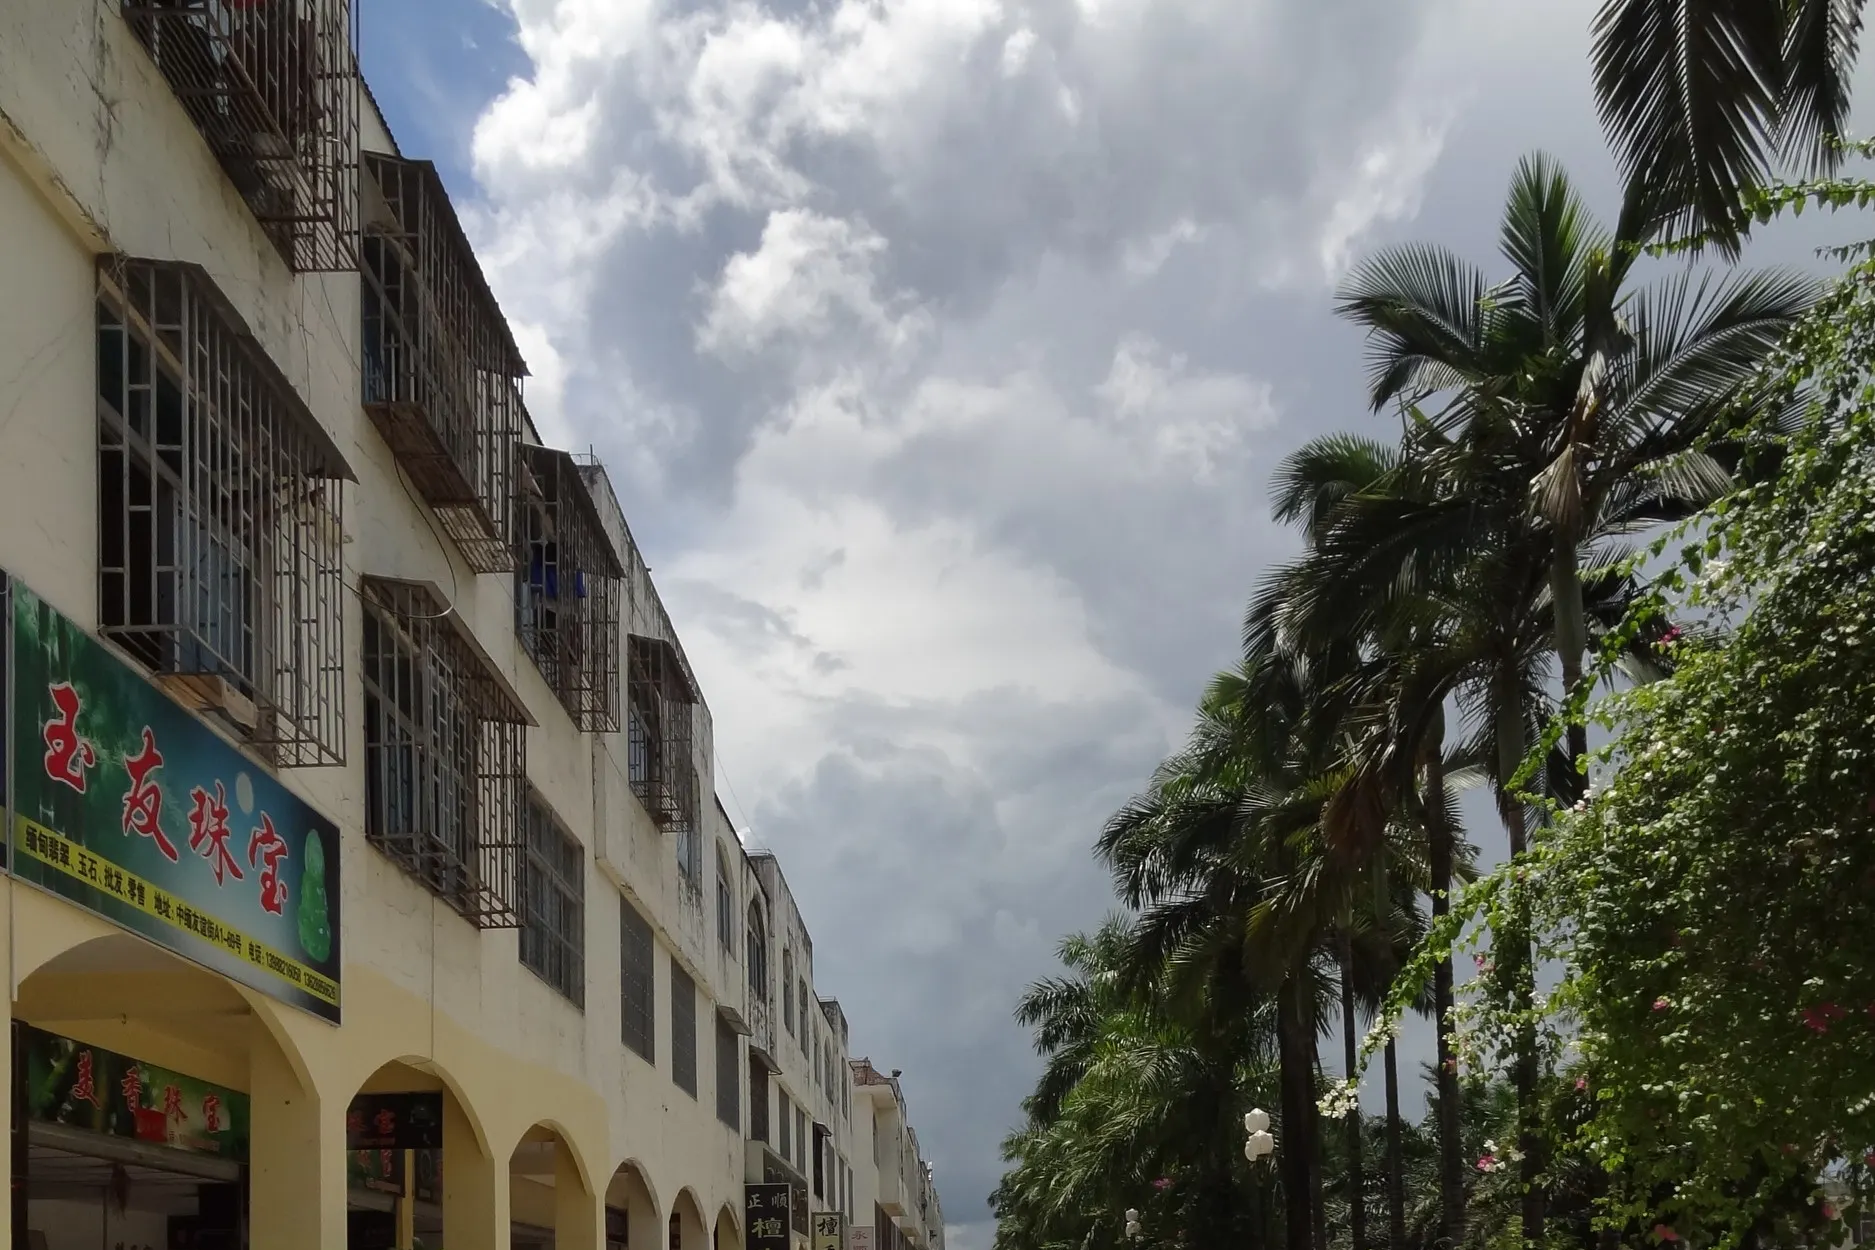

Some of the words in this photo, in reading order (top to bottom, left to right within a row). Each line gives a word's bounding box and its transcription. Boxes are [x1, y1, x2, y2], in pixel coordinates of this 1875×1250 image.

[42, 681, 290, 917] 玉友珠宝
[72, 1048, 220, 1134] 美香珠宝
